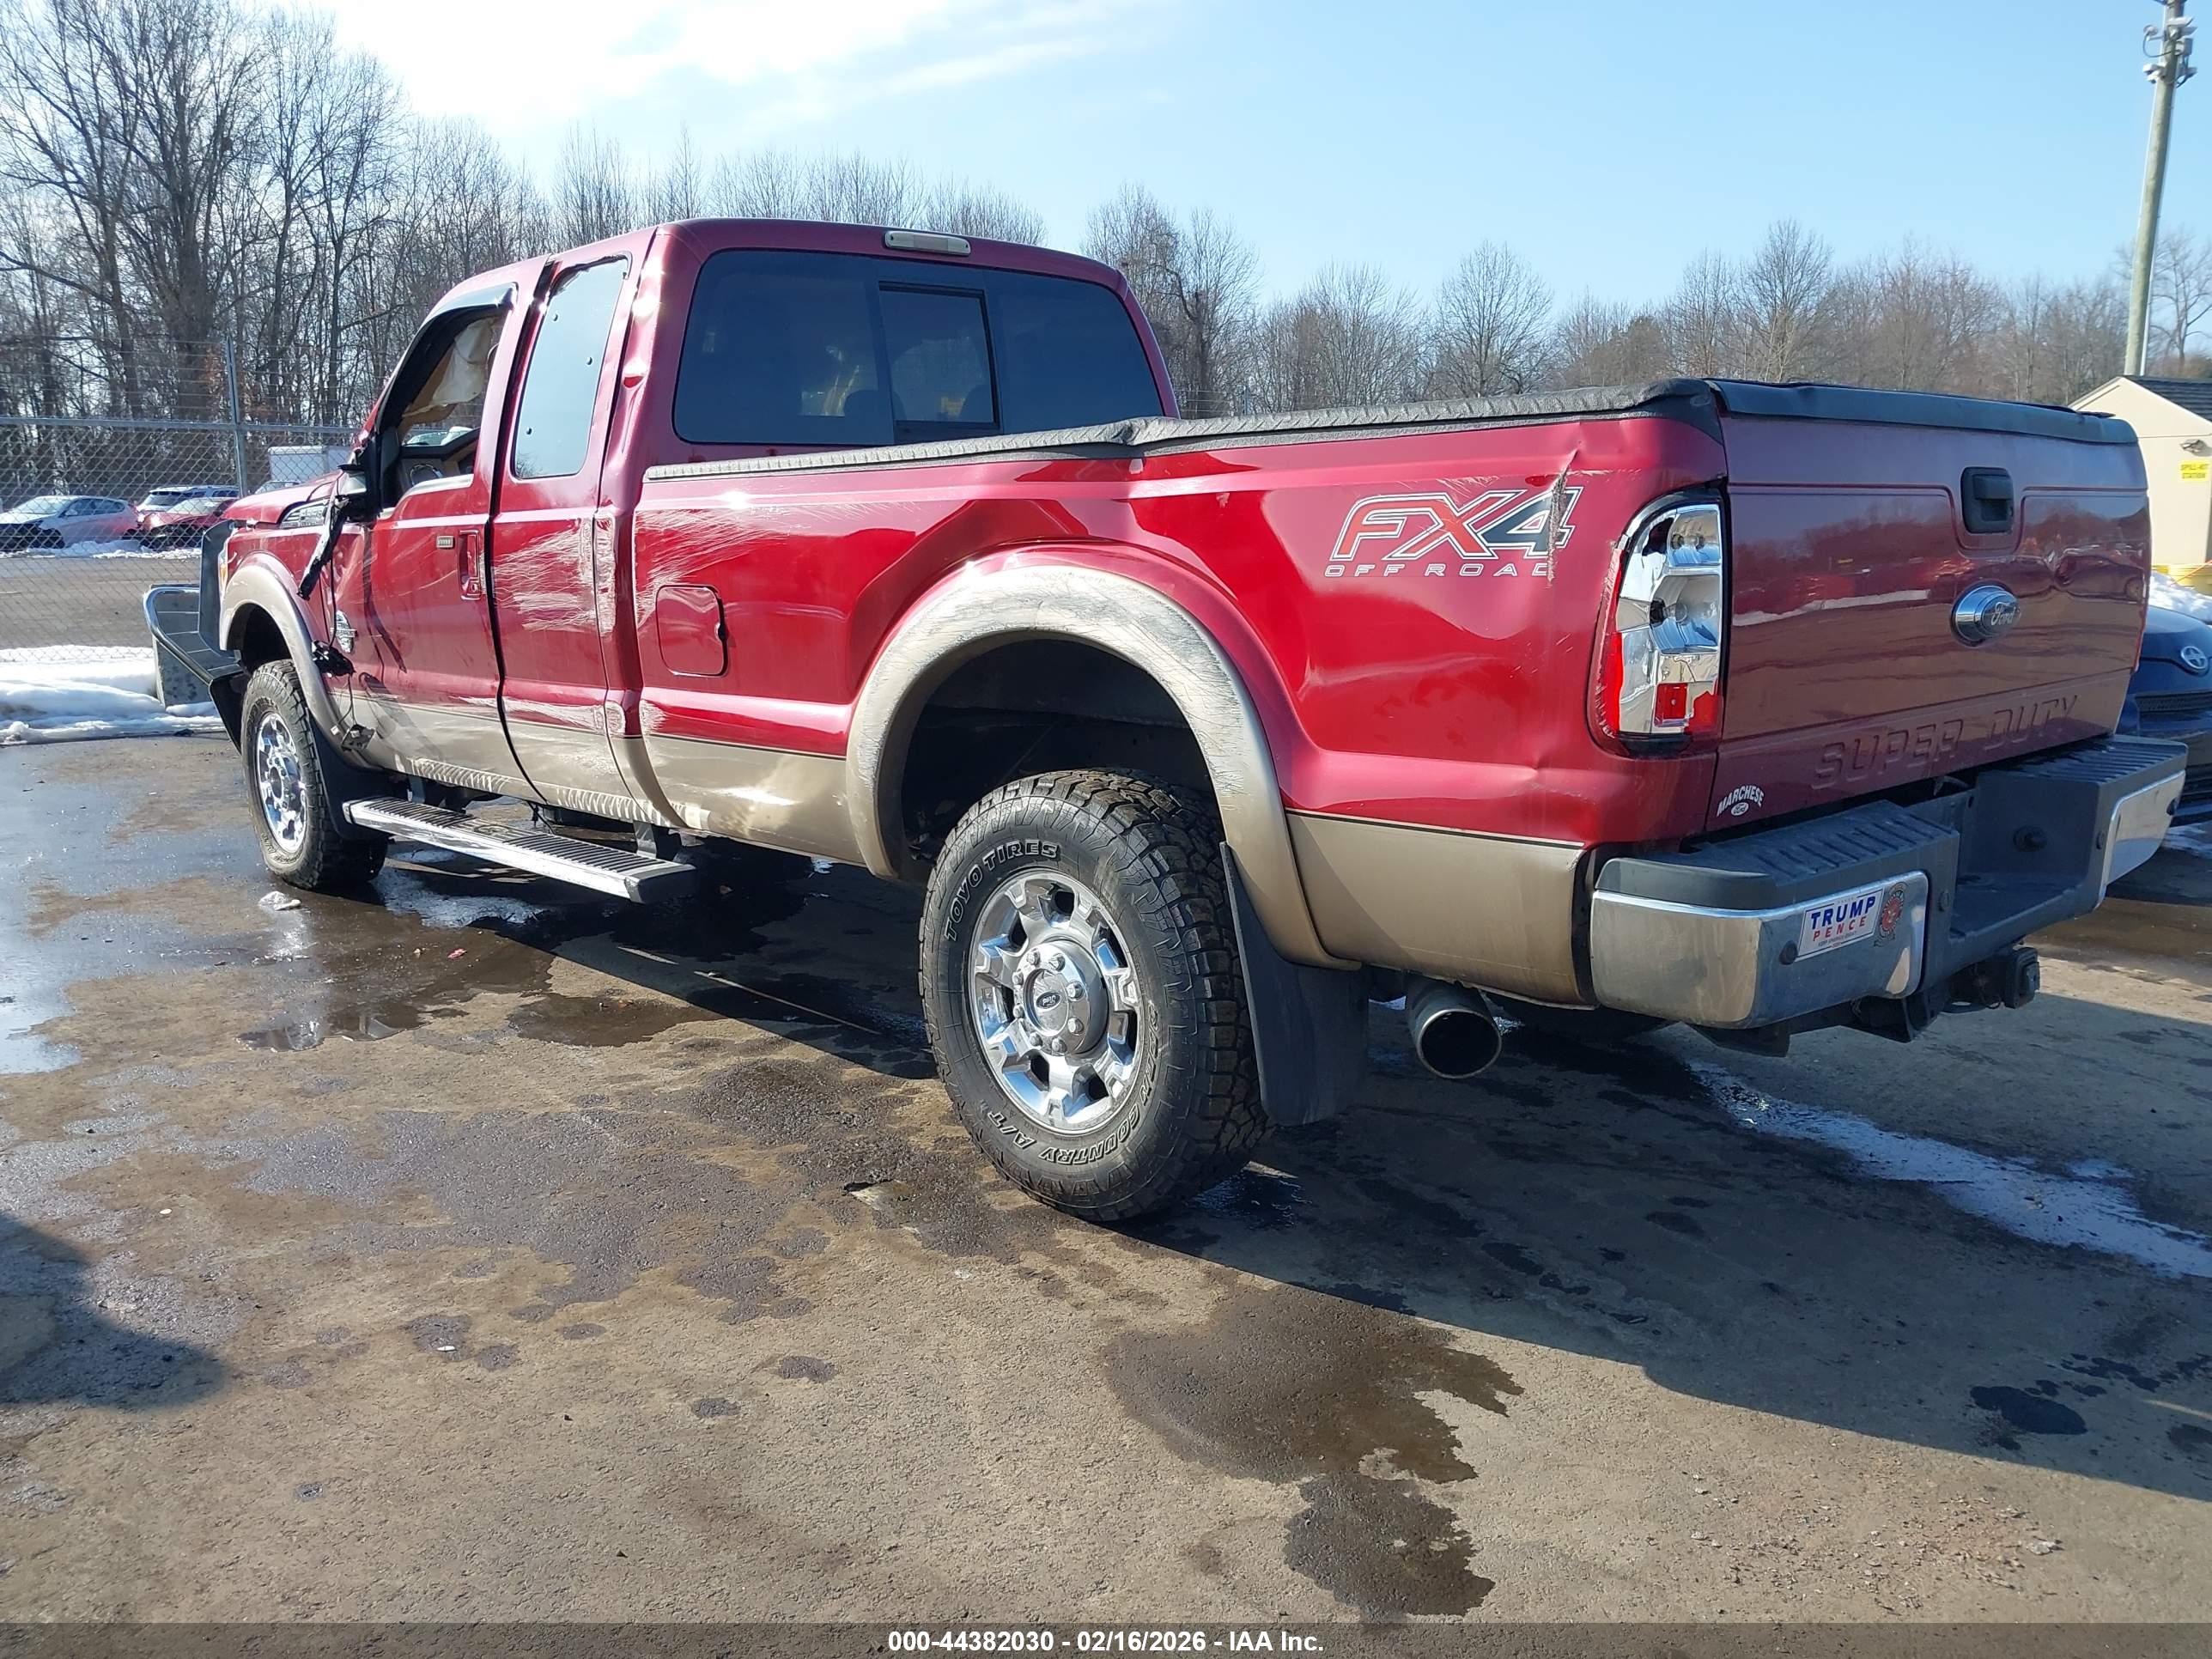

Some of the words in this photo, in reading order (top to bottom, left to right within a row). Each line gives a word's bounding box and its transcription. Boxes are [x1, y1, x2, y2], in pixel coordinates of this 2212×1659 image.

[1329, 486, 1583, 561] FX4
[1324, 563, 1406, 577] OFF
[1810, 718, 1964, 790] SUPER
[1984, 695, 2078, 750] DUTY
[1717, 785, 1765, 817] MARCHESE
[944, 864, 983, 942] TOYO
[982, 839, 1059, 872] TIRES
[1810, 896, 1876, 930] TRUMP
[1813, 915, 1867, 942] PENCE
[1140, 1002, 1159, 1106] OPEN
[988, 1110, 1036, 1149] A/T
[1039, 1104, 1140, 1165] COUNTRY
